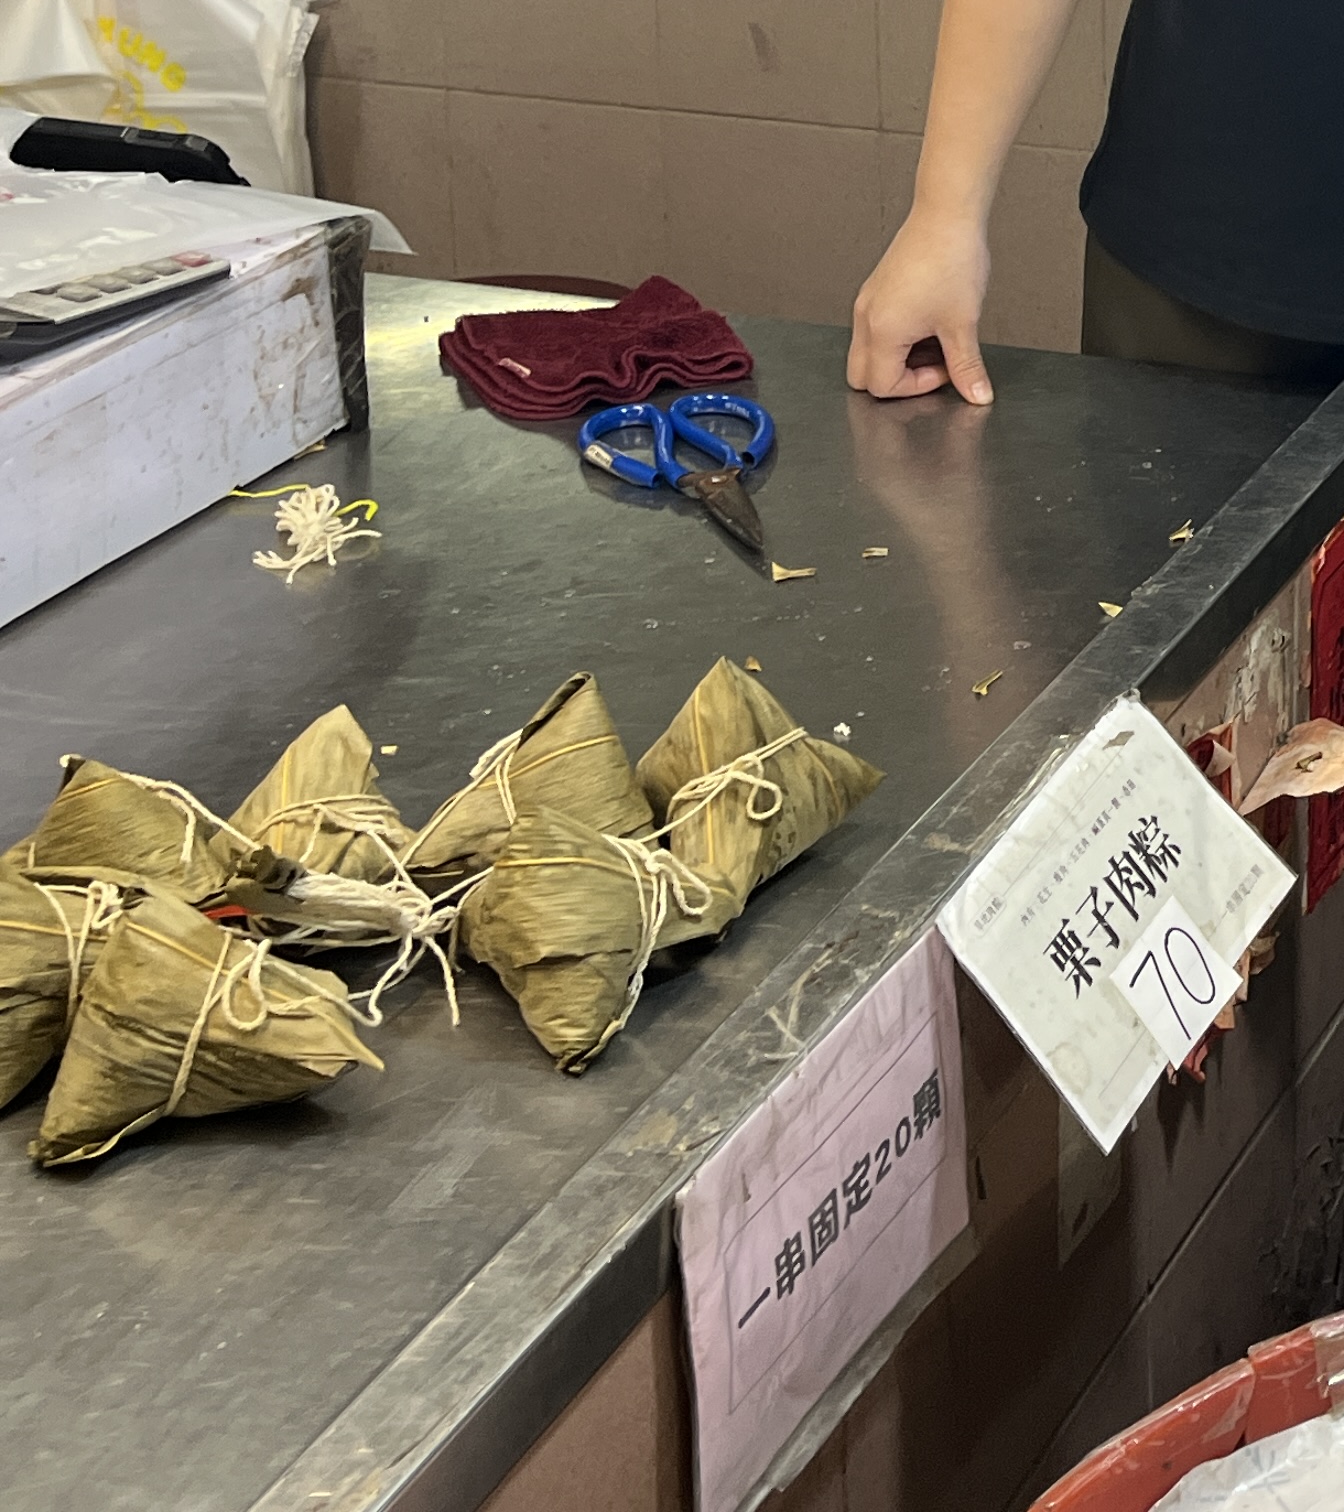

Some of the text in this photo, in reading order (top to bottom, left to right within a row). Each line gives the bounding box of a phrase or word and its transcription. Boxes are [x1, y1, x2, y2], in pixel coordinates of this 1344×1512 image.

[1042, 814, 1183, 1001] 栗子肉粽
[1129, 926, 1218, 1041] 70
[737, 1067, 942, 1330] 一串固定20顆
